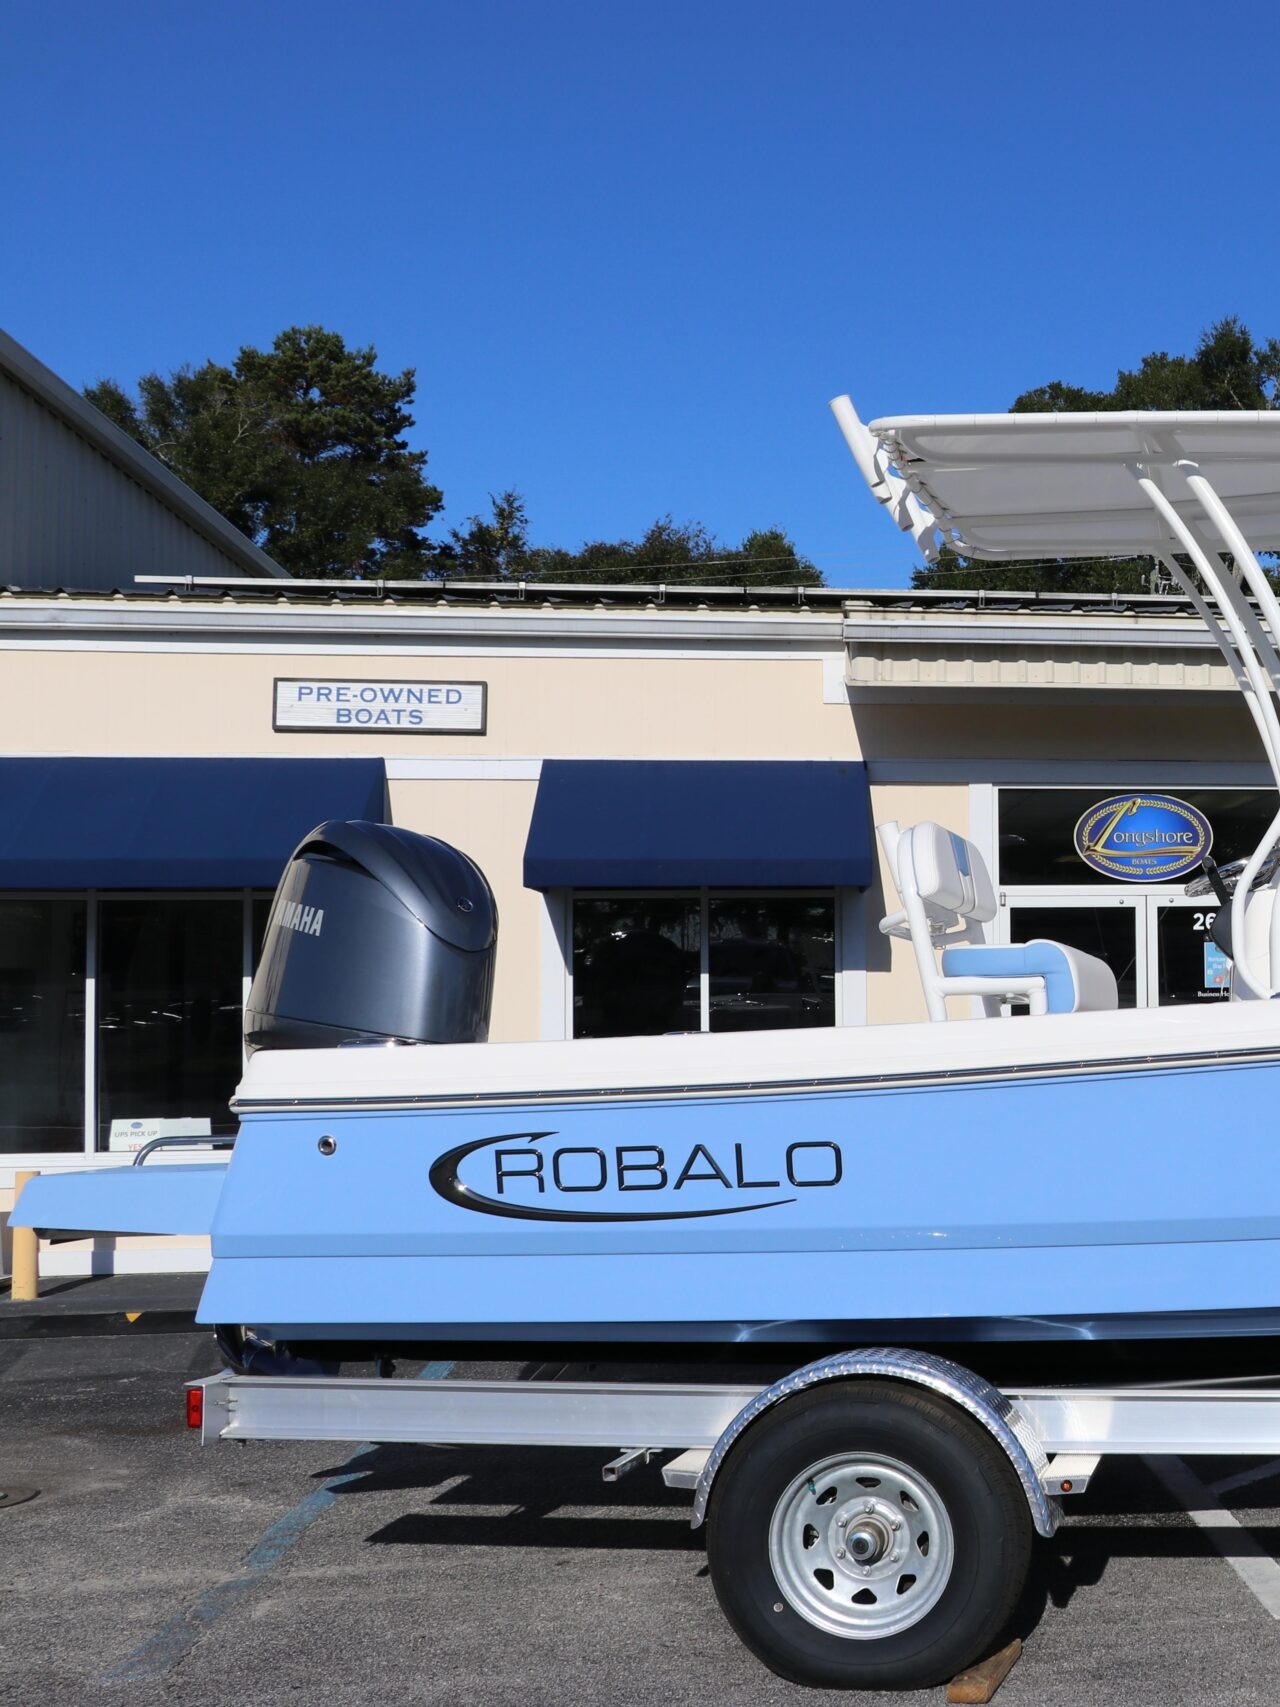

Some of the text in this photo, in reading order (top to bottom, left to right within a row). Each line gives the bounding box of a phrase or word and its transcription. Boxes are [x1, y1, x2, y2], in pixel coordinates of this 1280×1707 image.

[298, 686, 463, 704] PRE-OWNED
[336, 708, 424, 725] BOATS
[1083, 798, 1200, 857] Longshore
[1131, 858, 1157, 866] BOATS
[273, 899, 324, 937] AMAHA
[494, 1141, 843, 1194] ROBALO
